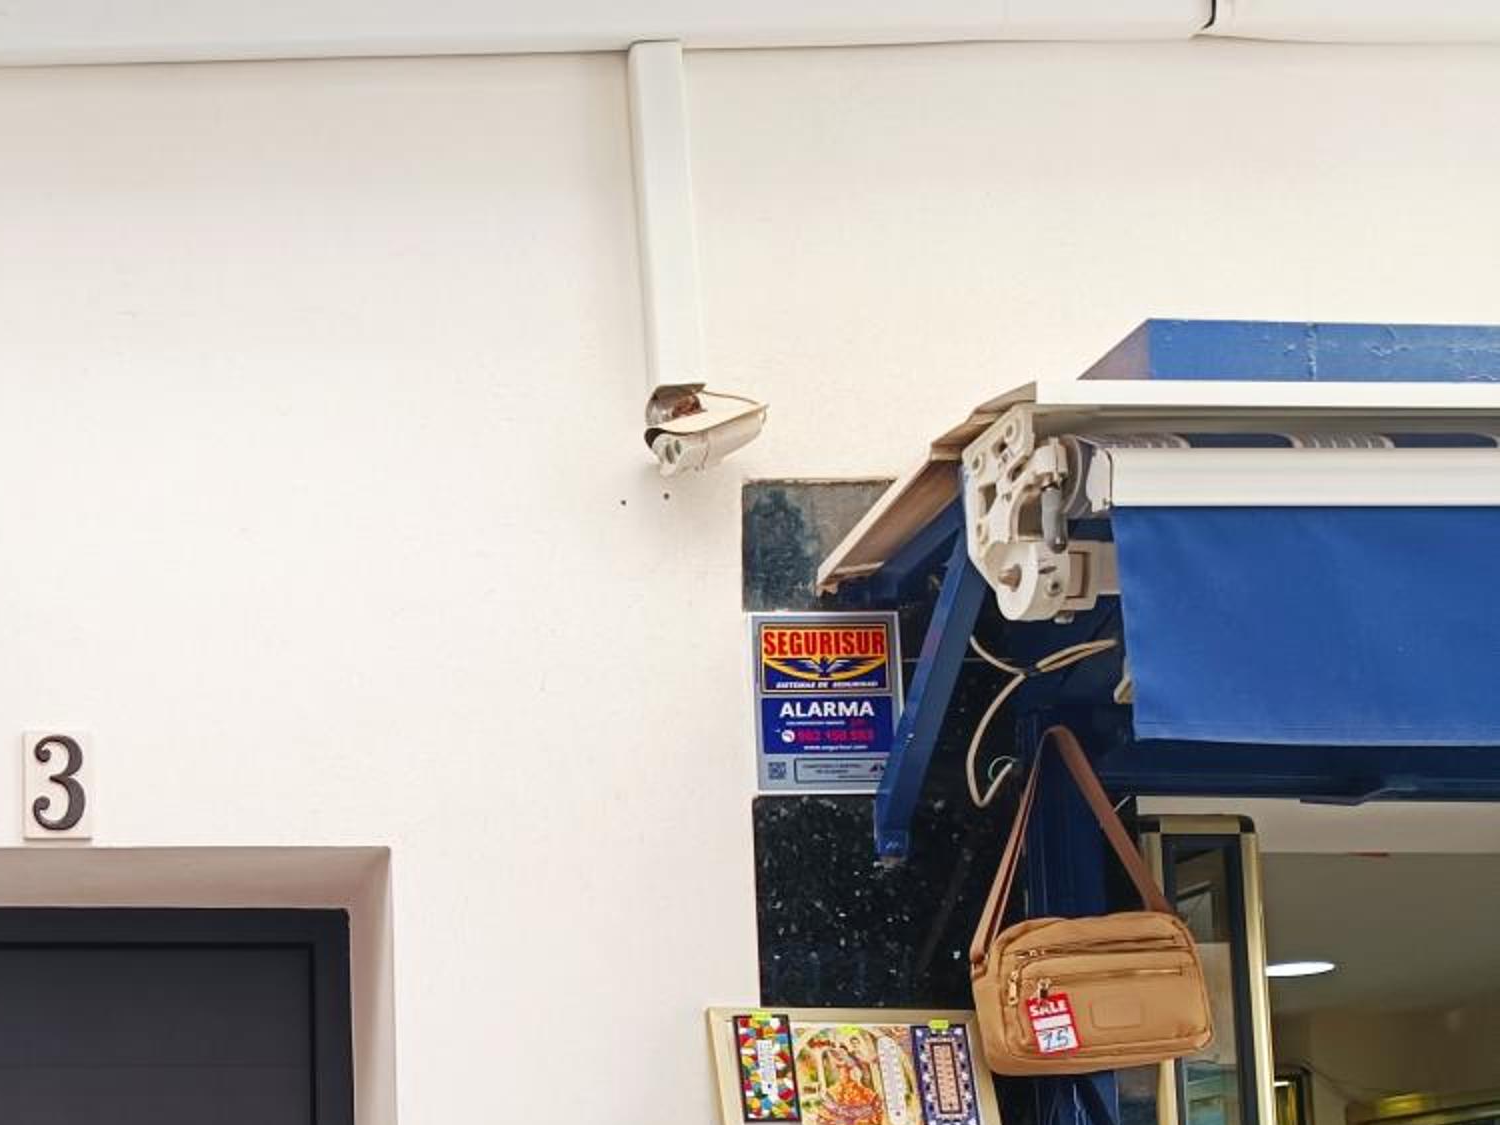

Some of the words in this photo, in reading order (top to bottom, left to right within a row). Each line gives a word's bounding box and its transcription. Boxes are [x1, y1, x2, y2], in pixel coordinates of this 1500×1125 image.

[763, 631, 885, 657] SEGURISUR
[779, 701, 875, 718] ALARMA
[32, 734, 86, 831] 3
[1029, 999, 1069, 1017] SALE
